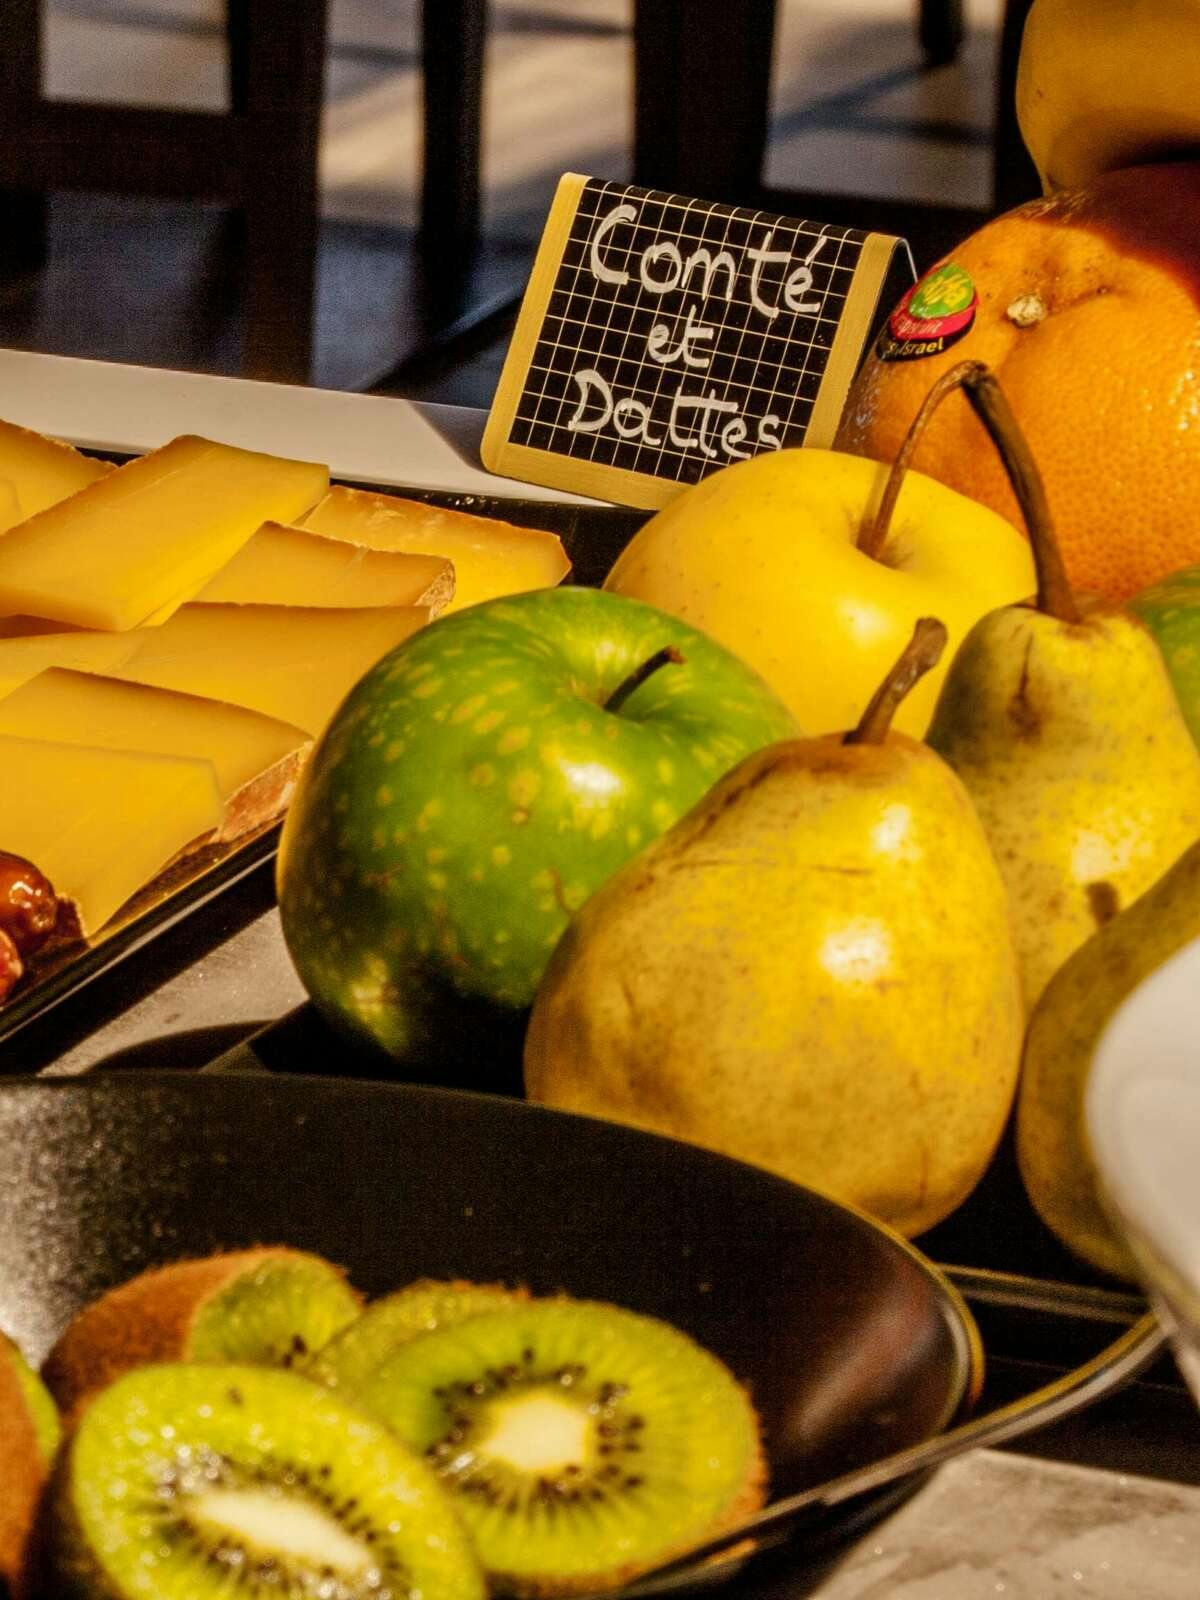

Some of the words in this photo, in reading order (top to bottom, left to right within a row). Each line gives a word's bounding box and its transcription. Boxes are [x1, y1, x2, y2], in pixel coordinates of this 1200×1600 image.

[590, 203, 828, 318] Comté
[648, 305, 713, 368] et
[568, 368, 782, 459] Dattes
